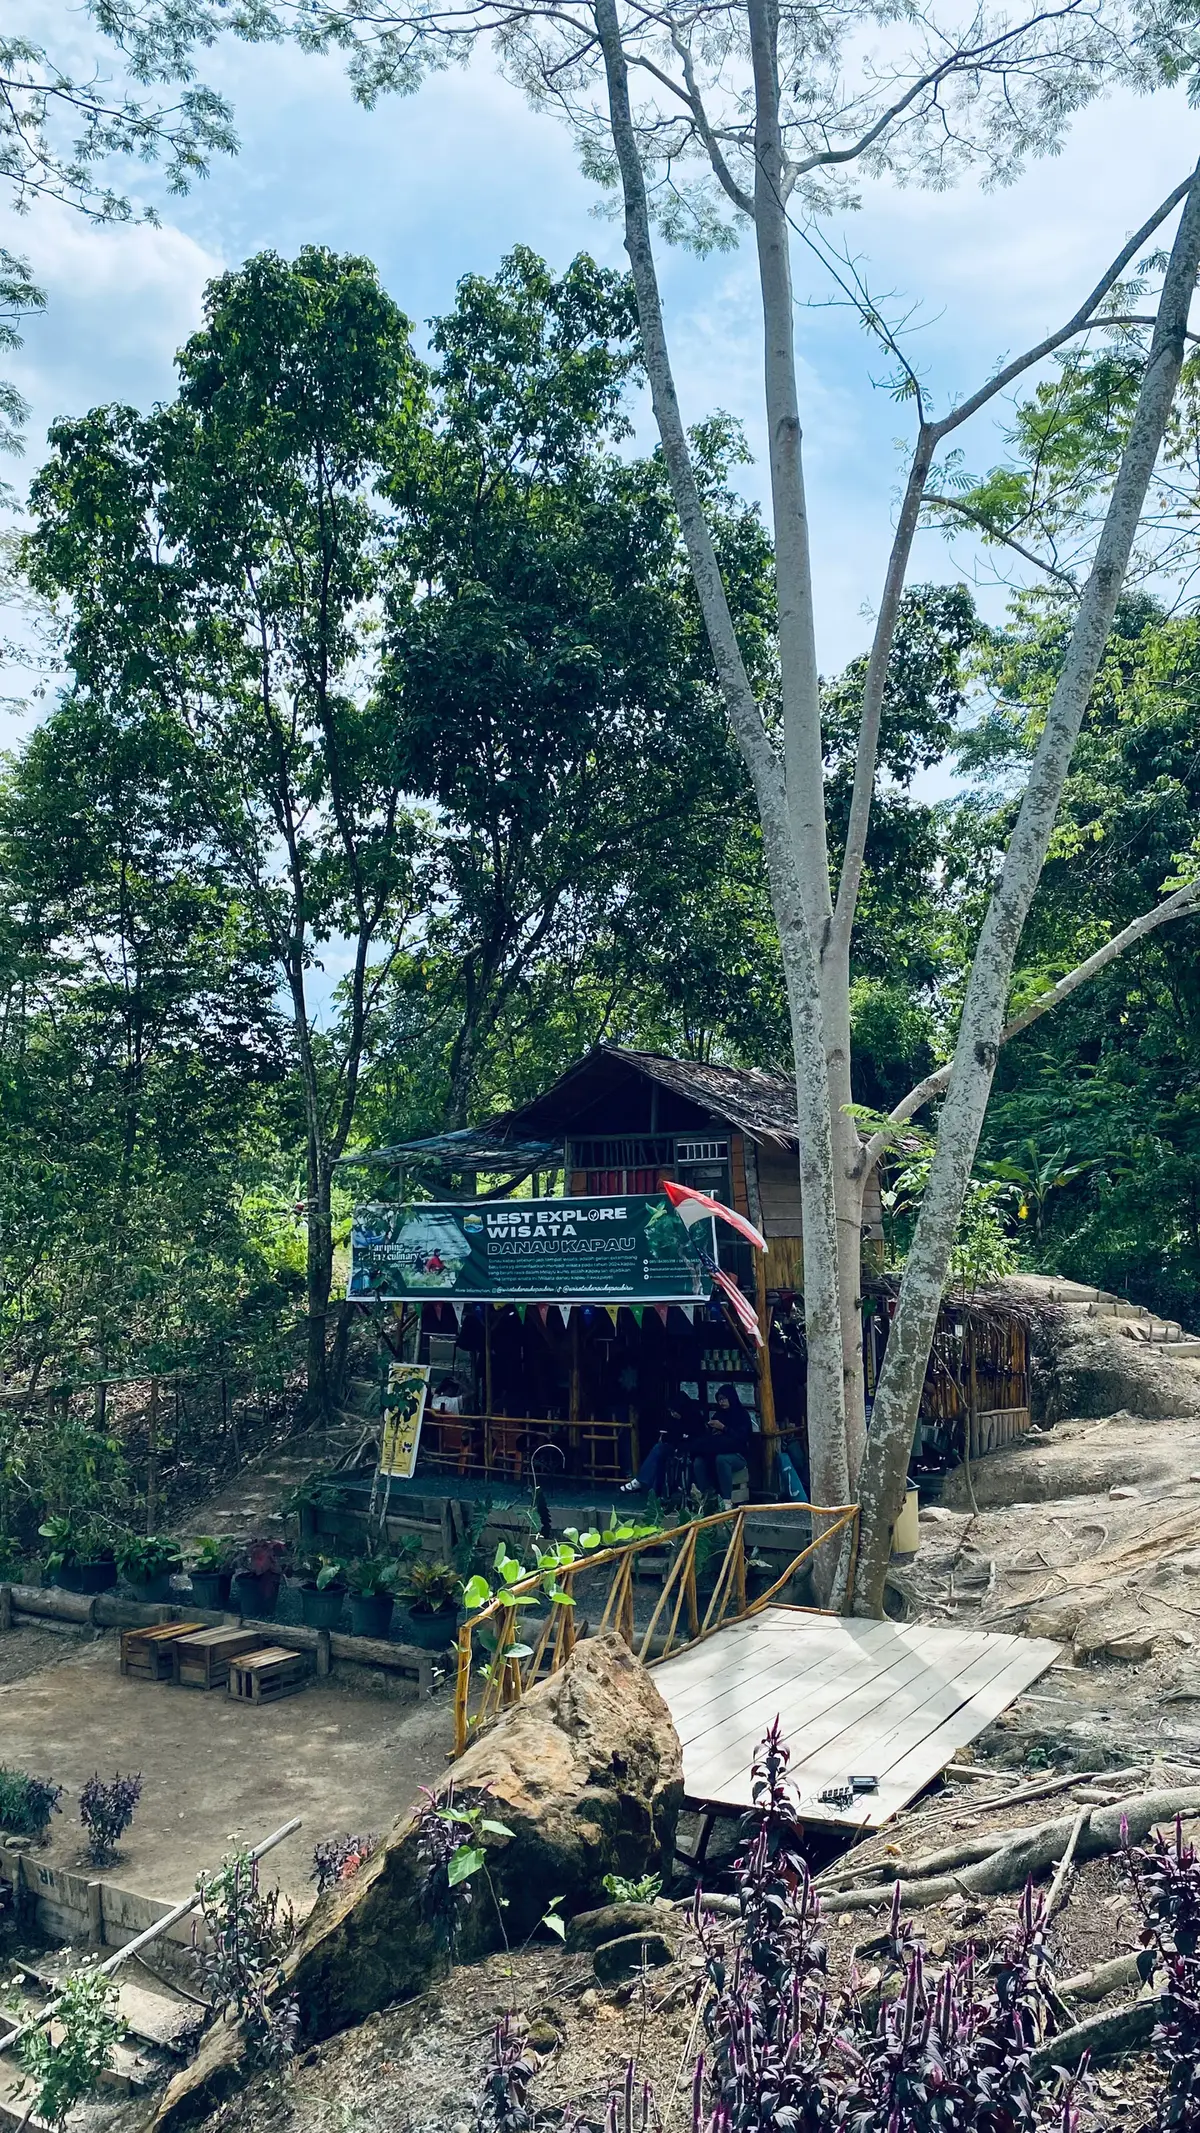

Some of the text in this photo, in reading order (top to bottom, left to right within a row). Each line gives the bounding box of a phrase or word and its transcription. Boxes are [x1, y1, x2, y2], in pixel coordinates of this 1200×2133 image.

[486, 1207, 628, 1225] LEST EXPLORE
[486, 1224, 578, 1239] WISATA
[487, 1237, 636, 1256] DANAU KAPAU
